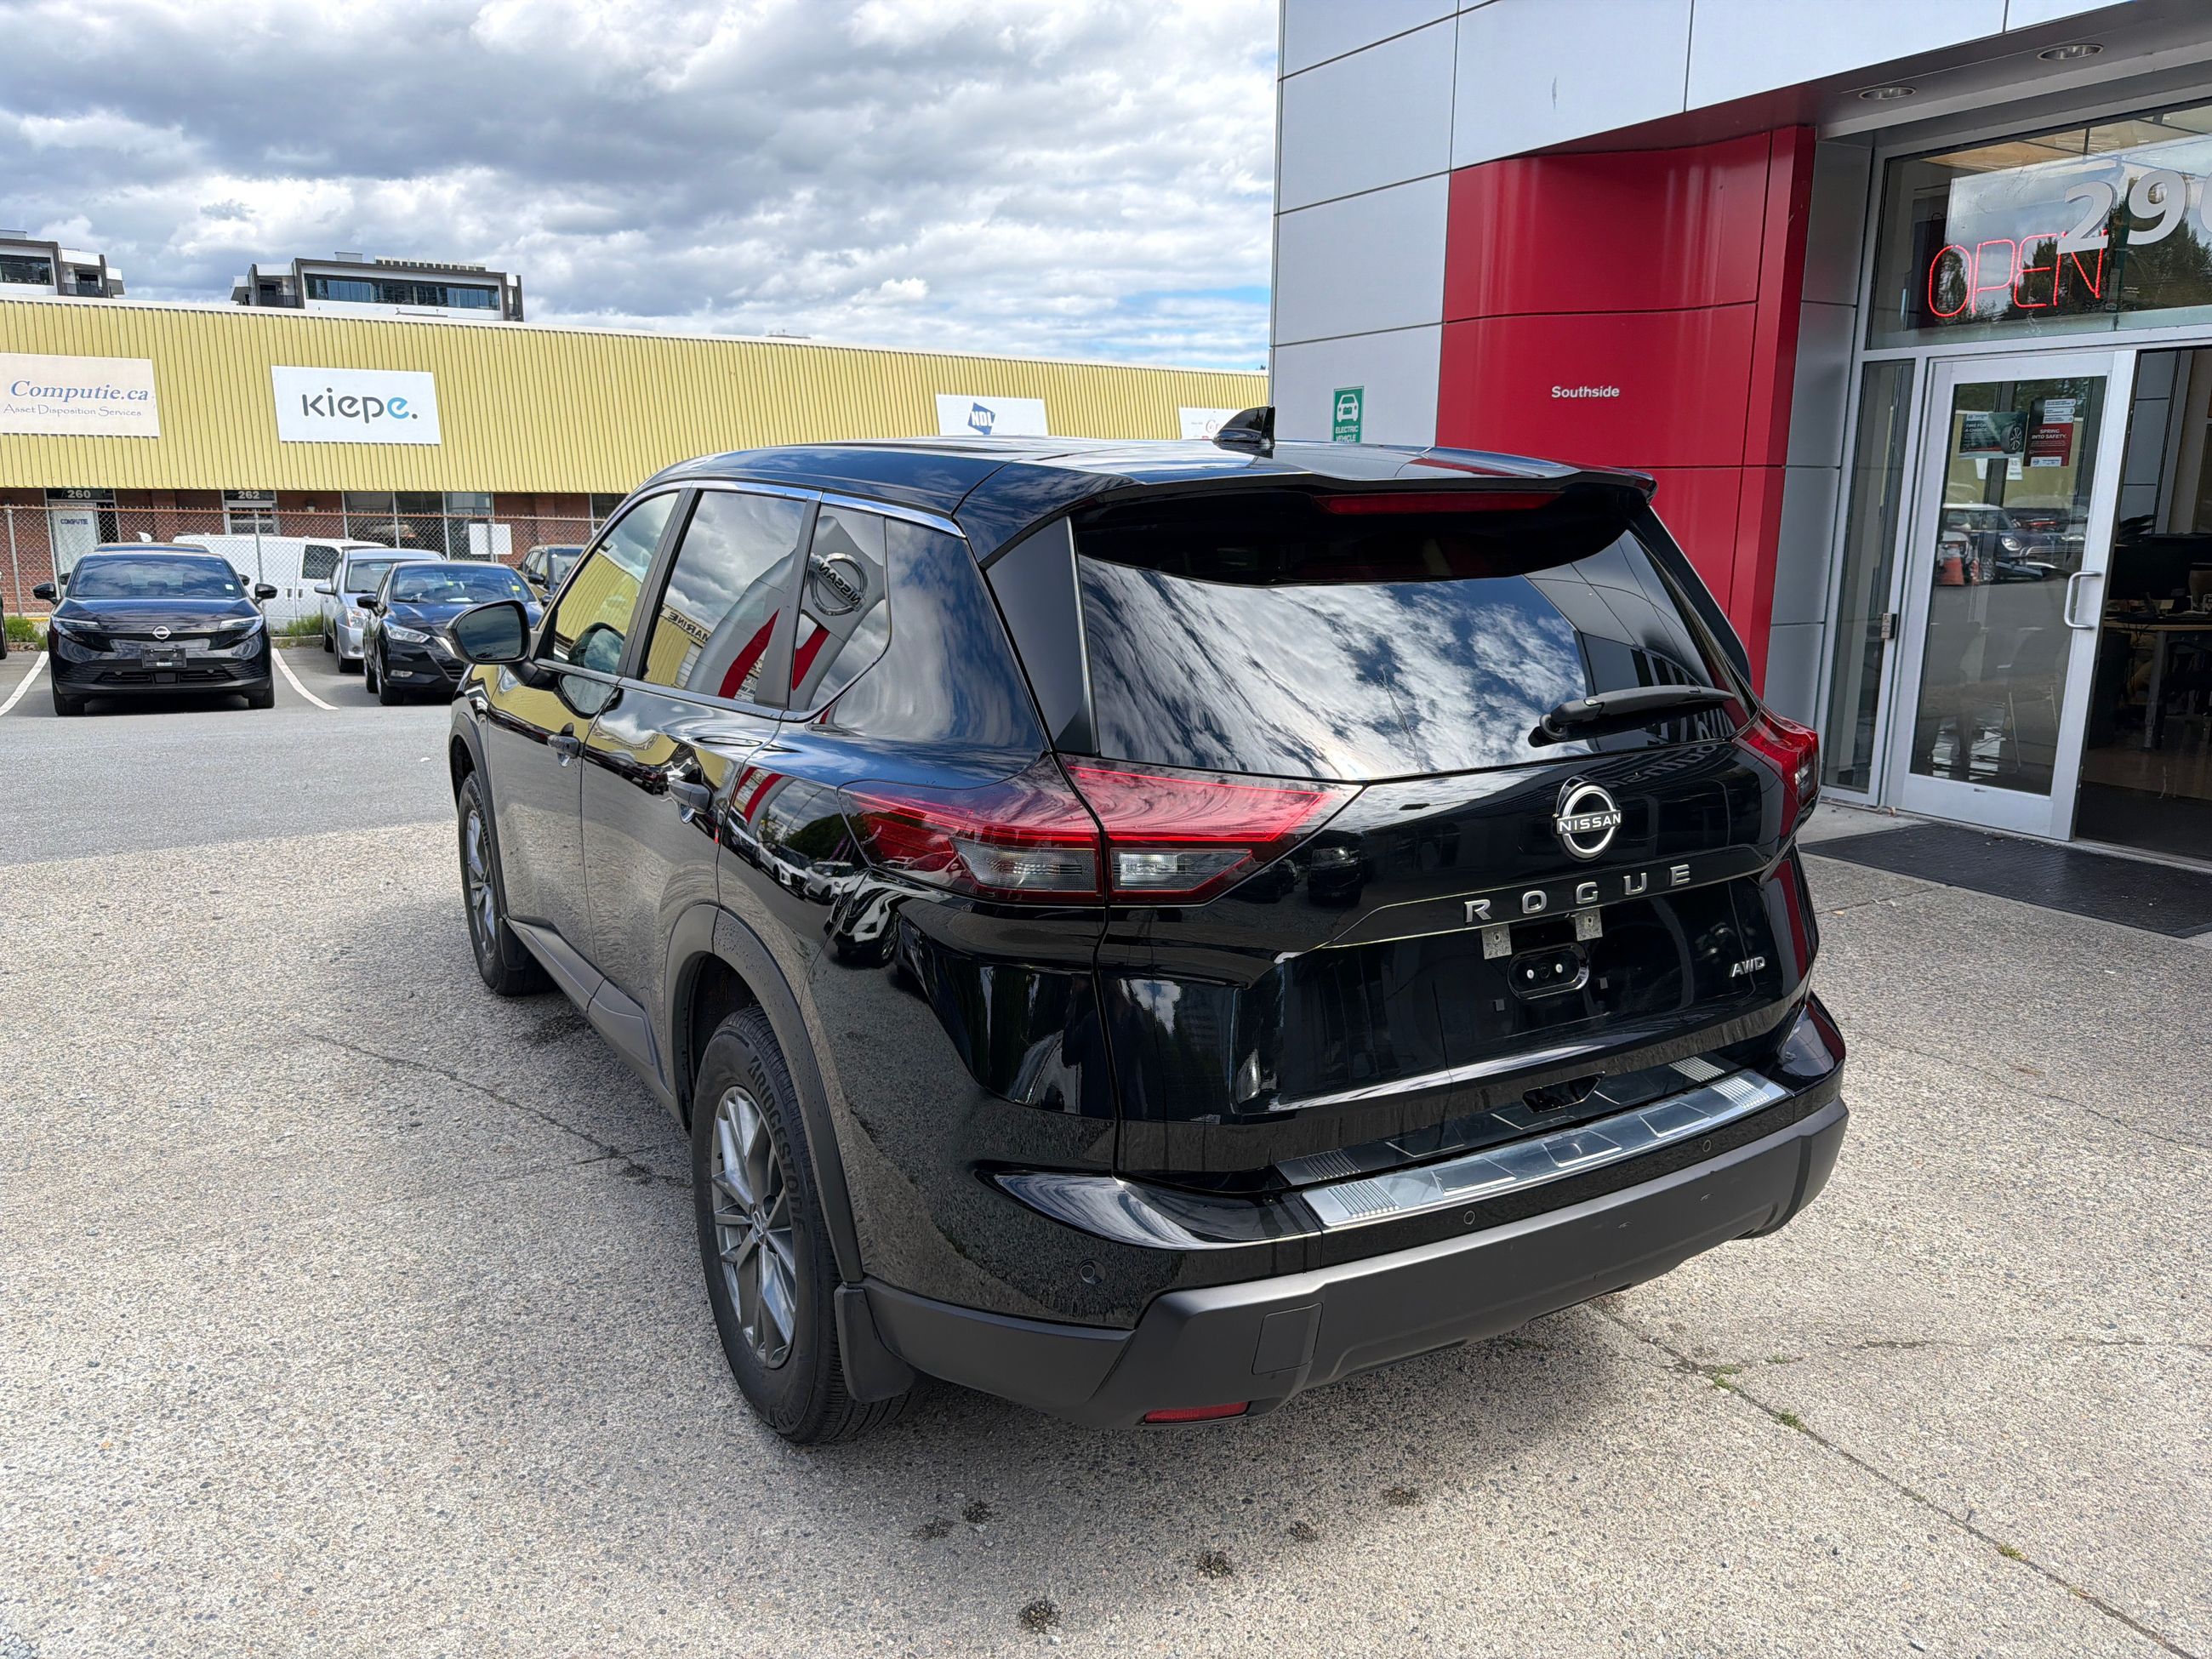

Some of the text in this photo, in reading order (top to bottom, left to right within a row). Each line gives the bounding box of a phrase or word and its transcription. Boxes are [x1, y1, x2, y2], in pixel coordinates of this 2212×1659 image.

[2056, 169, 2212, 254] 29
[1928, 228, 2108, 317] OPEN
[10, 380, 149, 402] Computie.ca
[1551, 385, 1620, 398] Southside
[3, 403, 142, 417] Asset Disposition Services
[1335, 425, 1359, 434] ELECTRIC
[1336, 434, 1357, 442] VEHICLE
[67, 489, 91, 499] 260
[237, 490, 260, 499] 262
[1559, 812, 1622, 832] NISSAN
[1464, 864, 1690, 923] ROGUE
[1730, 955, 1766, 978] AWD
